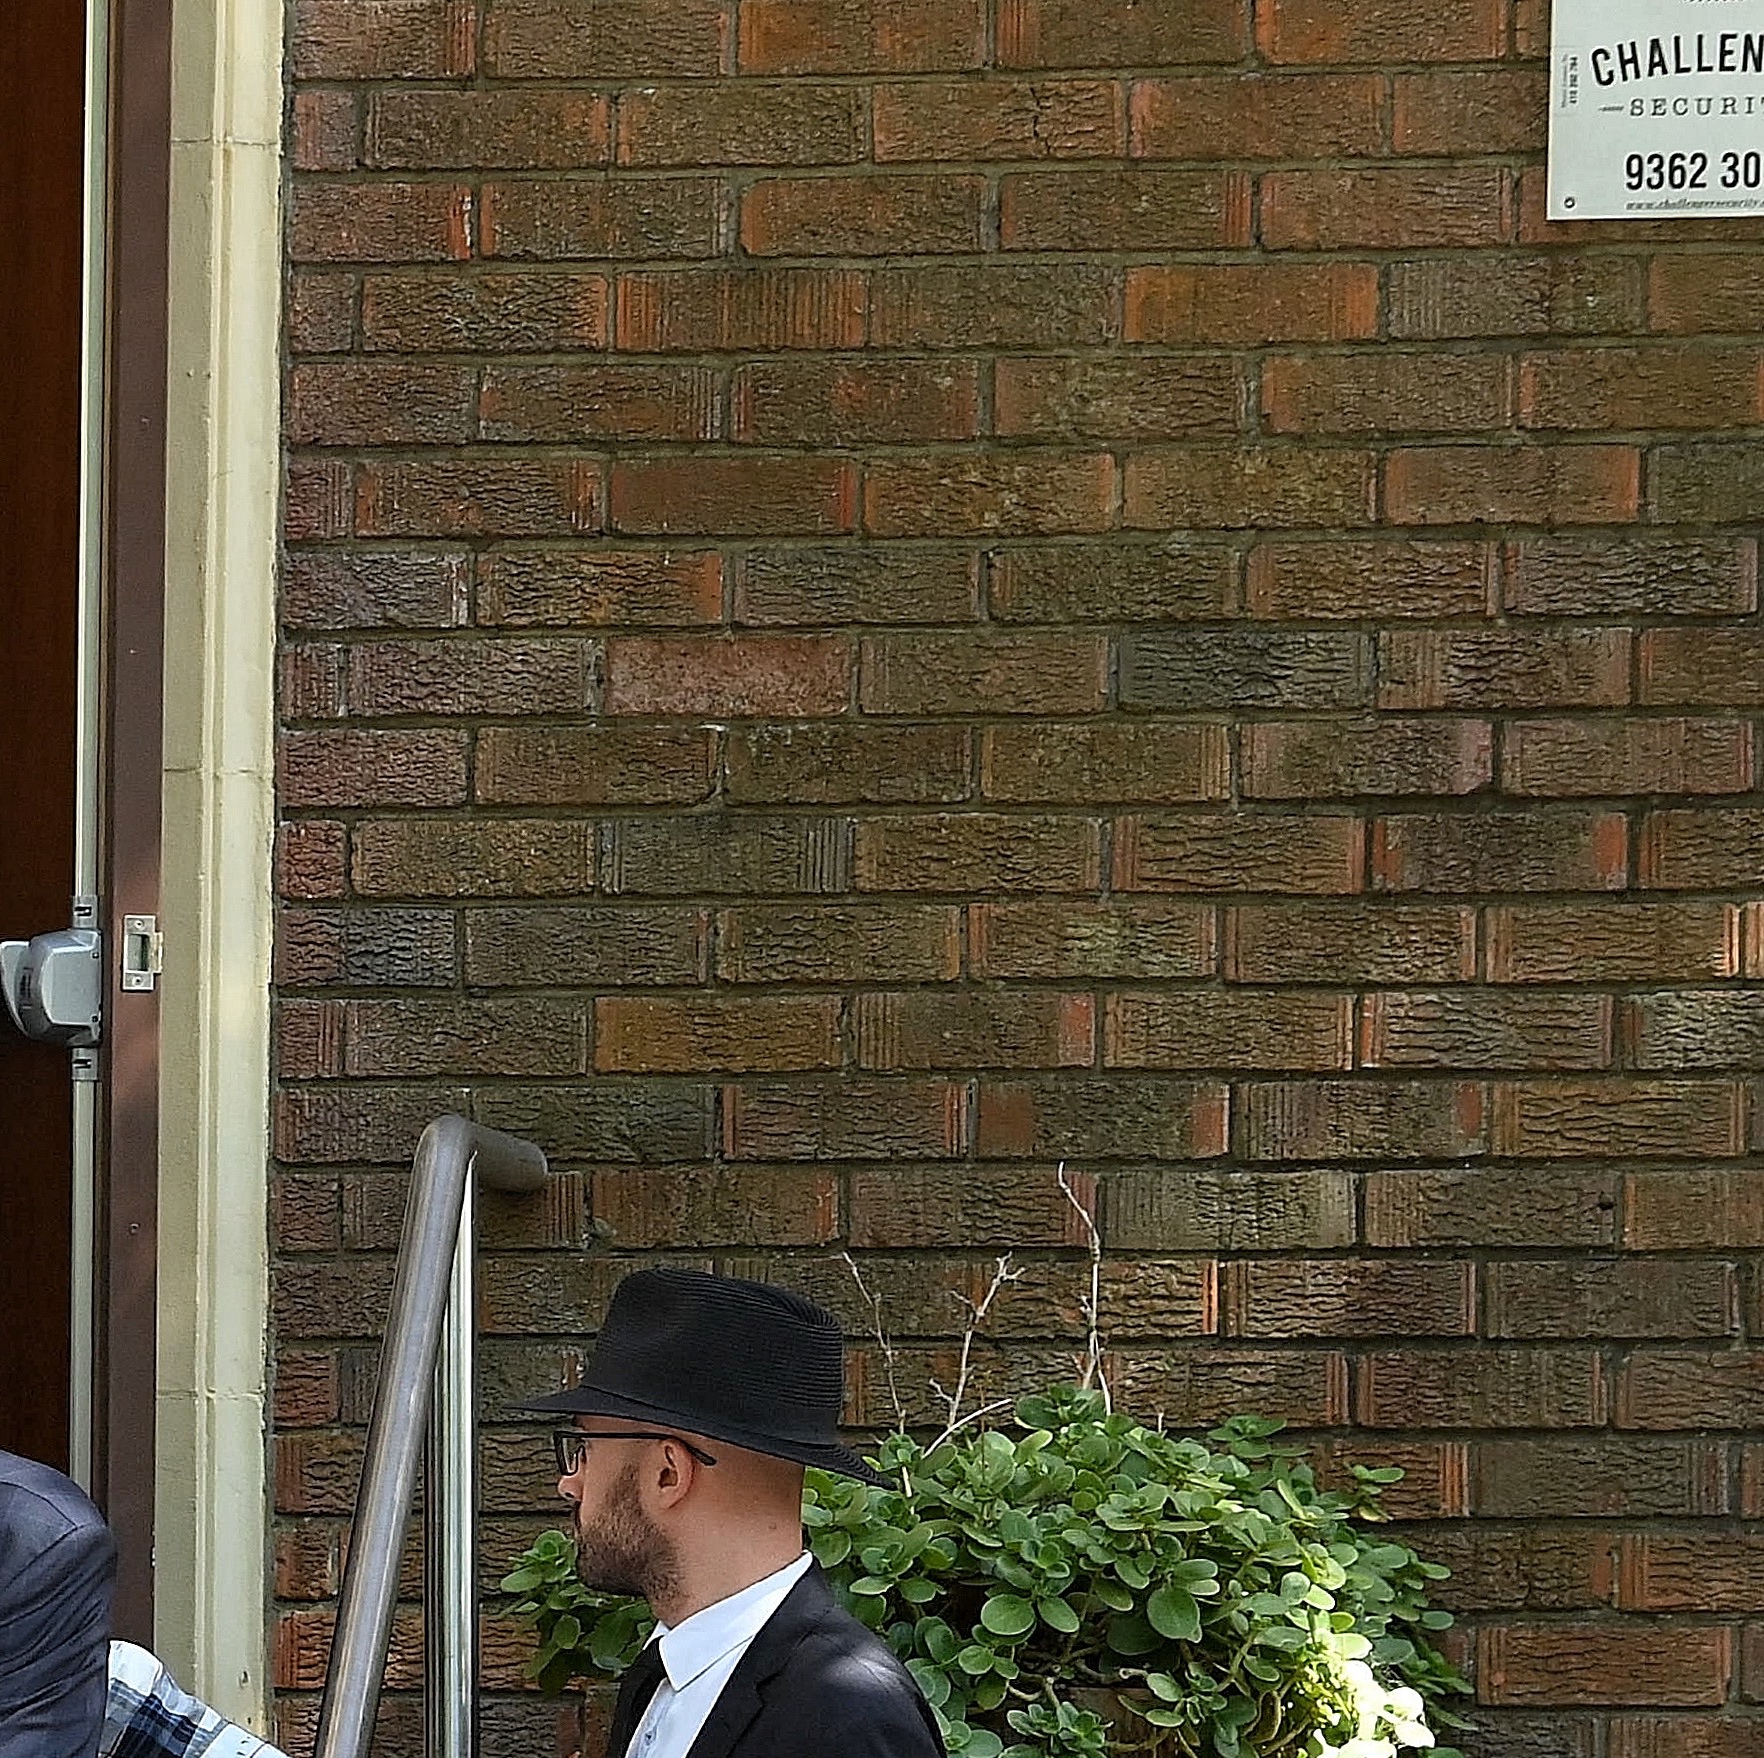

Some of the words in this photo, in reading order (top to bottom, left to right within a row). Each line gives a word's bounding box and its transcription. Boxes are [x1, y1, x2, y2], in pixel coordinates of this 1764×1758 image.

[1591, 33, 1764, 87] CHALLEN
[1629, 97, 1764, 117] SECURI
[1625, 152, 1708, 191] 9362
[1721, 151, 1762, 190] 30
